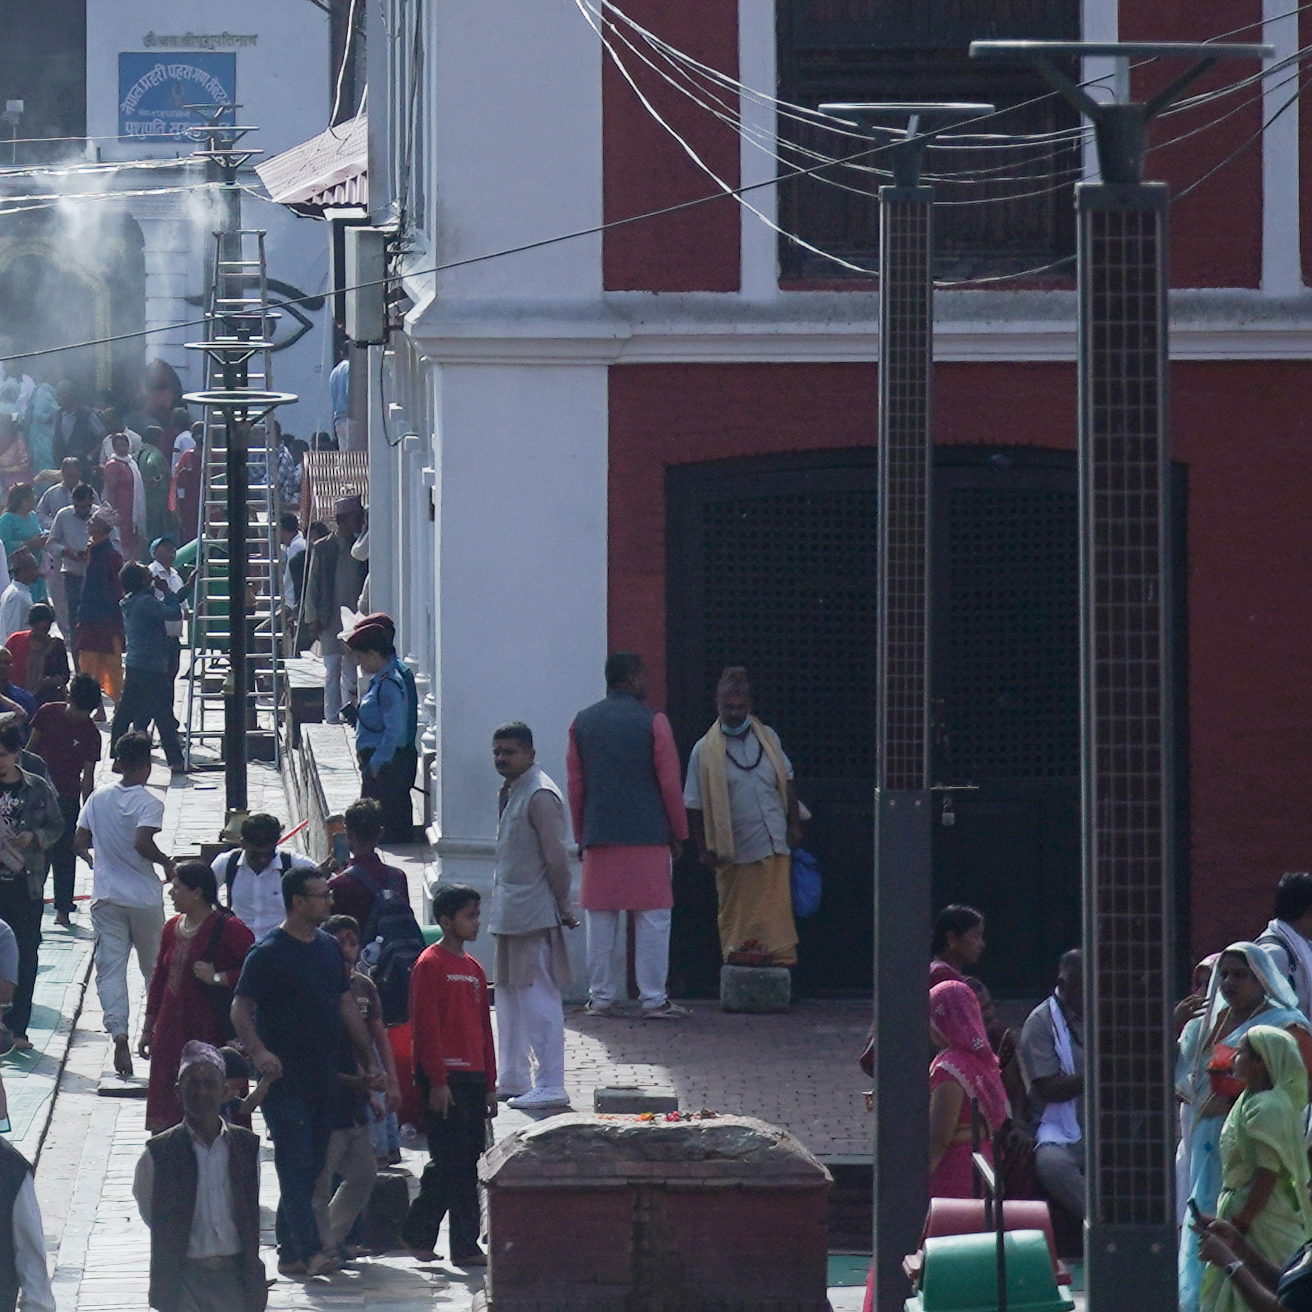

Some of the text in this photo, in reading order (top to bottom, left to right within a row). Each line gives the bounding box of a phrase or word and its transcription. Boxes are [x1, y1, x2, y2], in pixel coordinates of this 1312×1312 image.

[120, 83, 145, 116] नेपाल
[138, 63, 168, 91] प्रहरी
[125, 118, 167, 141] पशुपति
